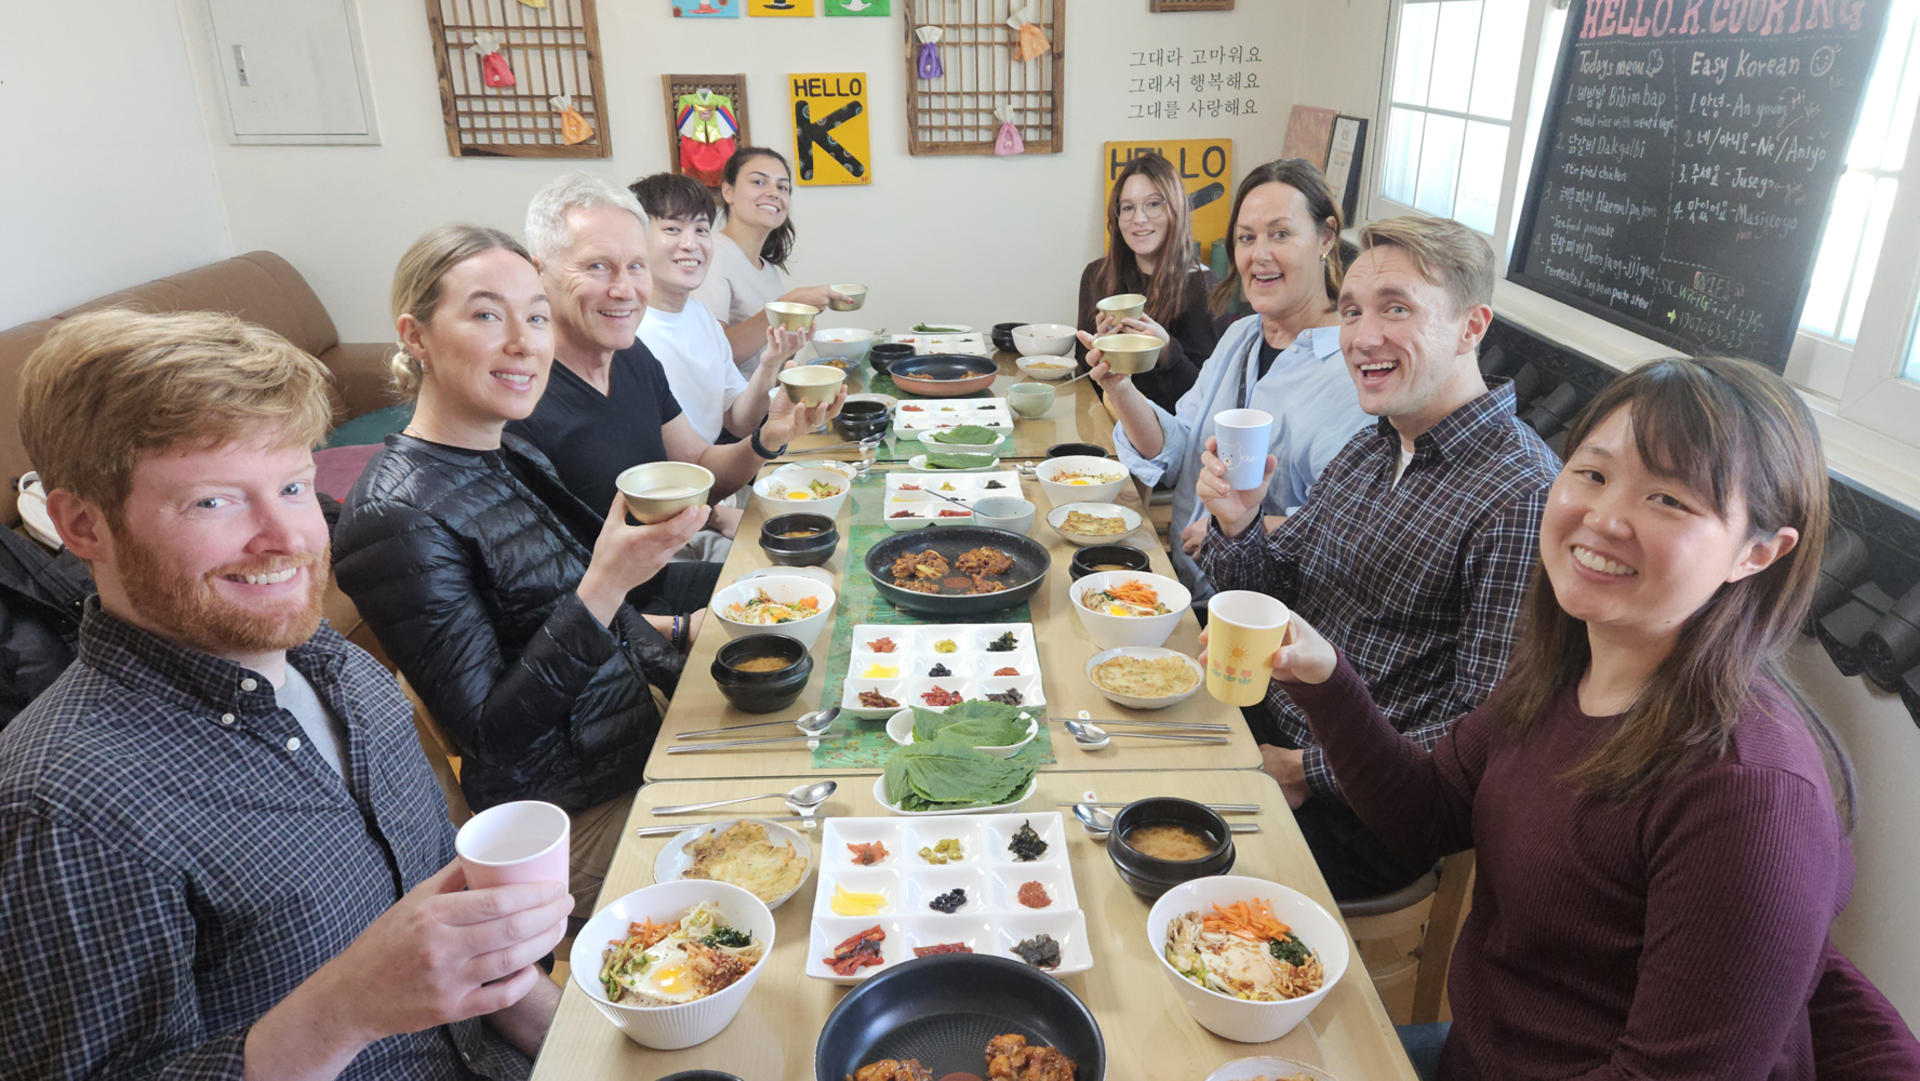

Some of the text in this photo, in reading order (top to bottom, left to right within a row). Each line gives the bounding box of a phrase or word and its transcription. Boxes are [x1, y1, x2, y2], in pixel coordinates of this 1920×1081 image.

[1190, 45, 1262, 65] 고마워요
[1690, 48, 1800, 85] Easy Korean
[793, 78, 862, 97] HELLO
[1128, 72, 1260, 94] 그래서 행복해요
[1576, 83, 1607, 109] 비빔밥
[1127, 98, 1259, 119] 그대를 사랑해요
[795, 100, 865, 181] K
[1568, 133, 1596, 157] 닭갈비
[1111, 145, 1226, 180] HLO
[1691, 163, 1720, 187] 주세요
